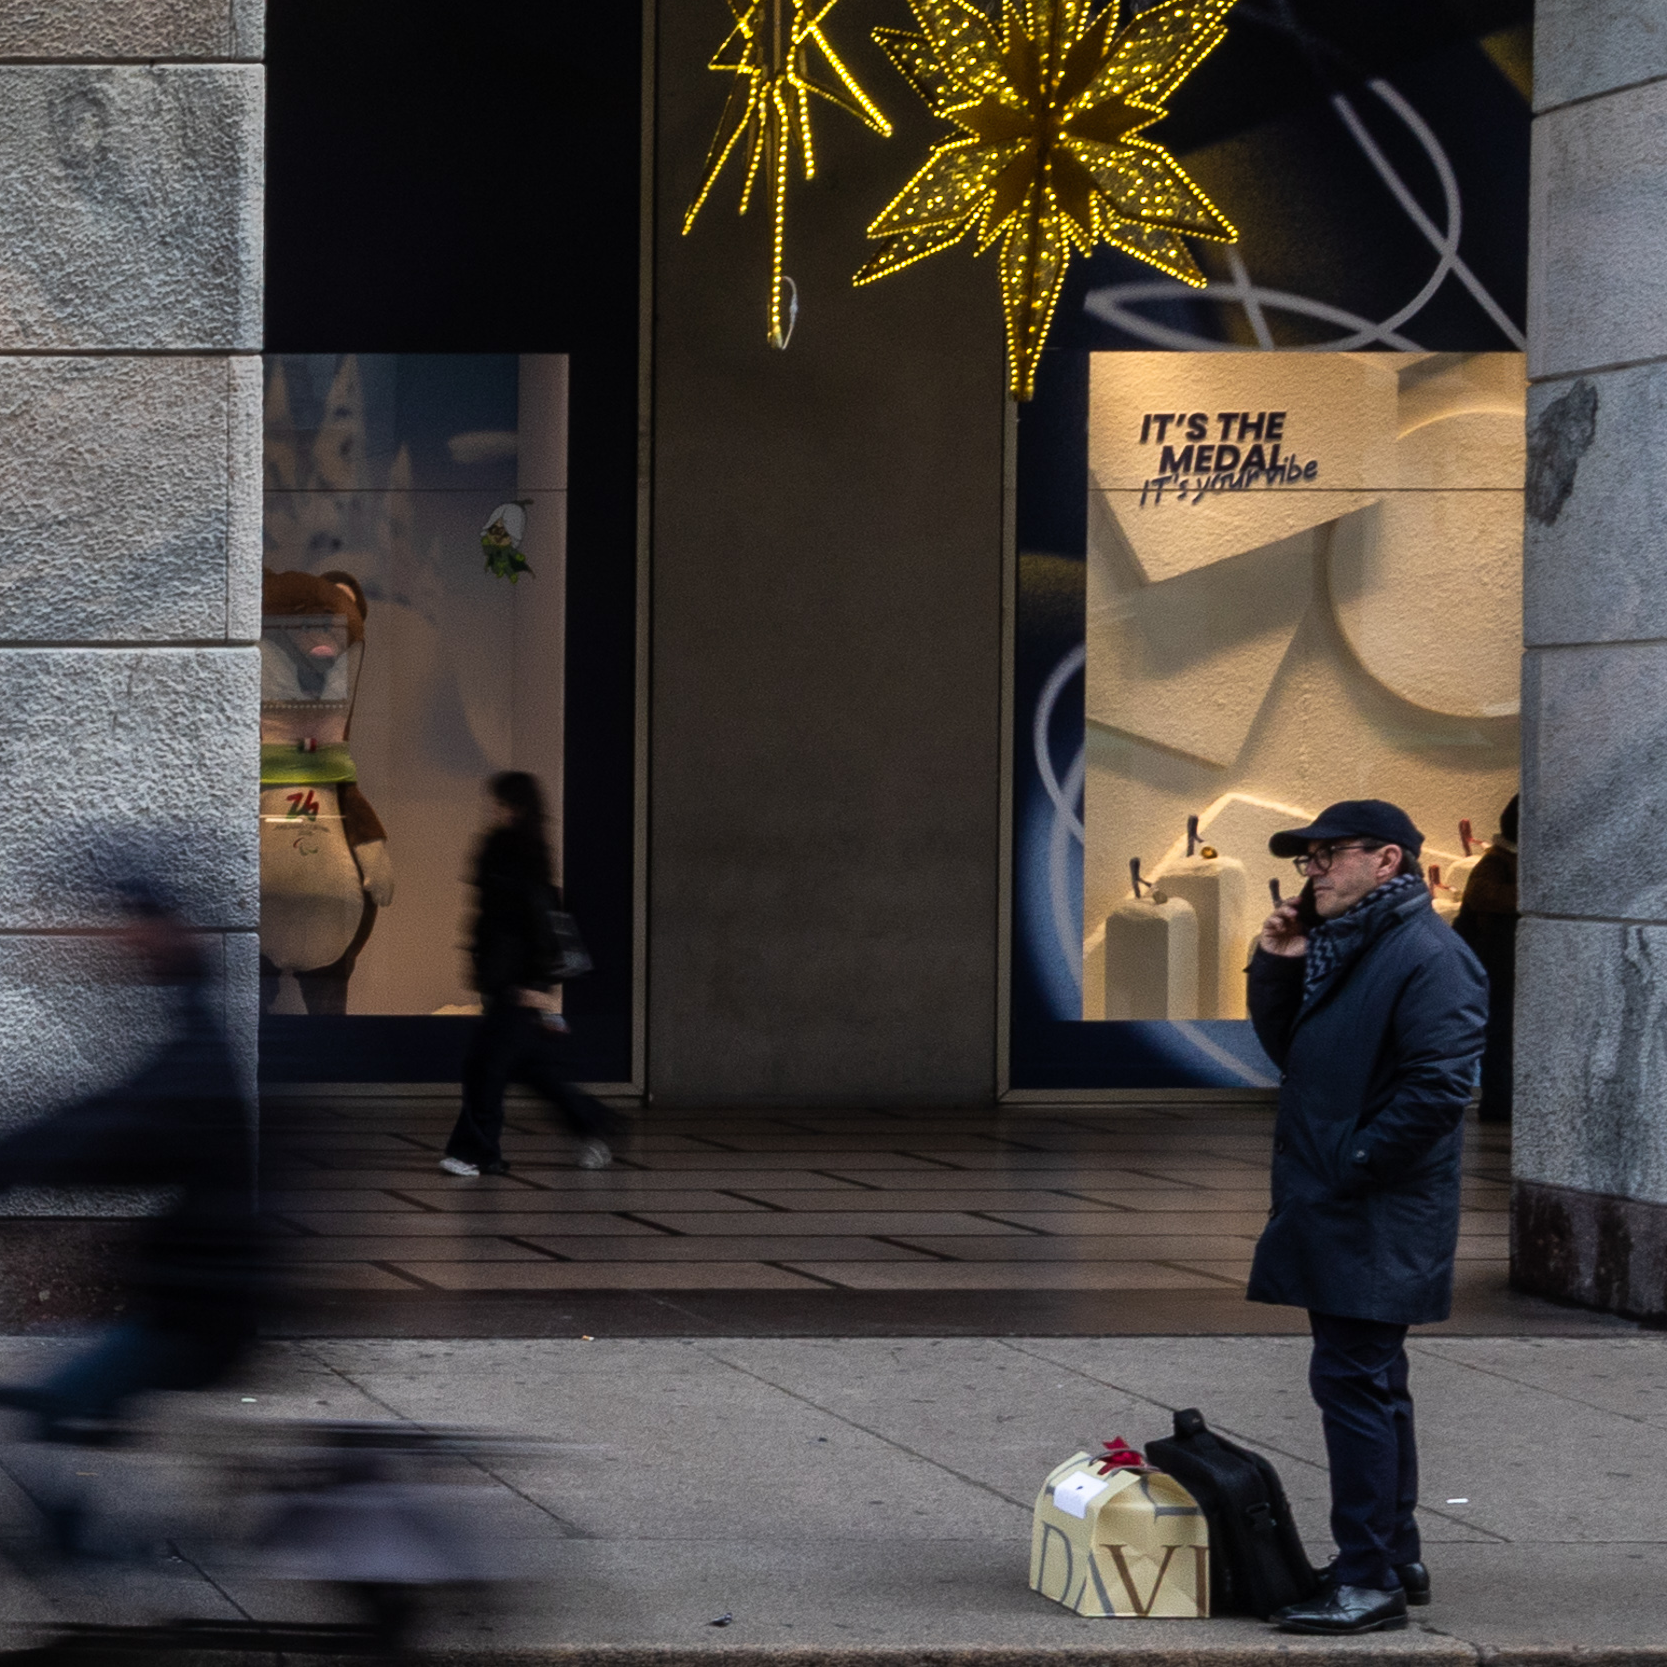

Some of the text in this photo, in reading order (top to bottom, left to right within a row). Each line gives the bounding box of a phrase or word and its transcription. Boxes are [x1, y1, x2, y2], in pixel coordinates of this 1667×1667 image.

[1140, 411, 1287, 444] IT'S THE
[1158, 443, 1282, 475] MEDAL
